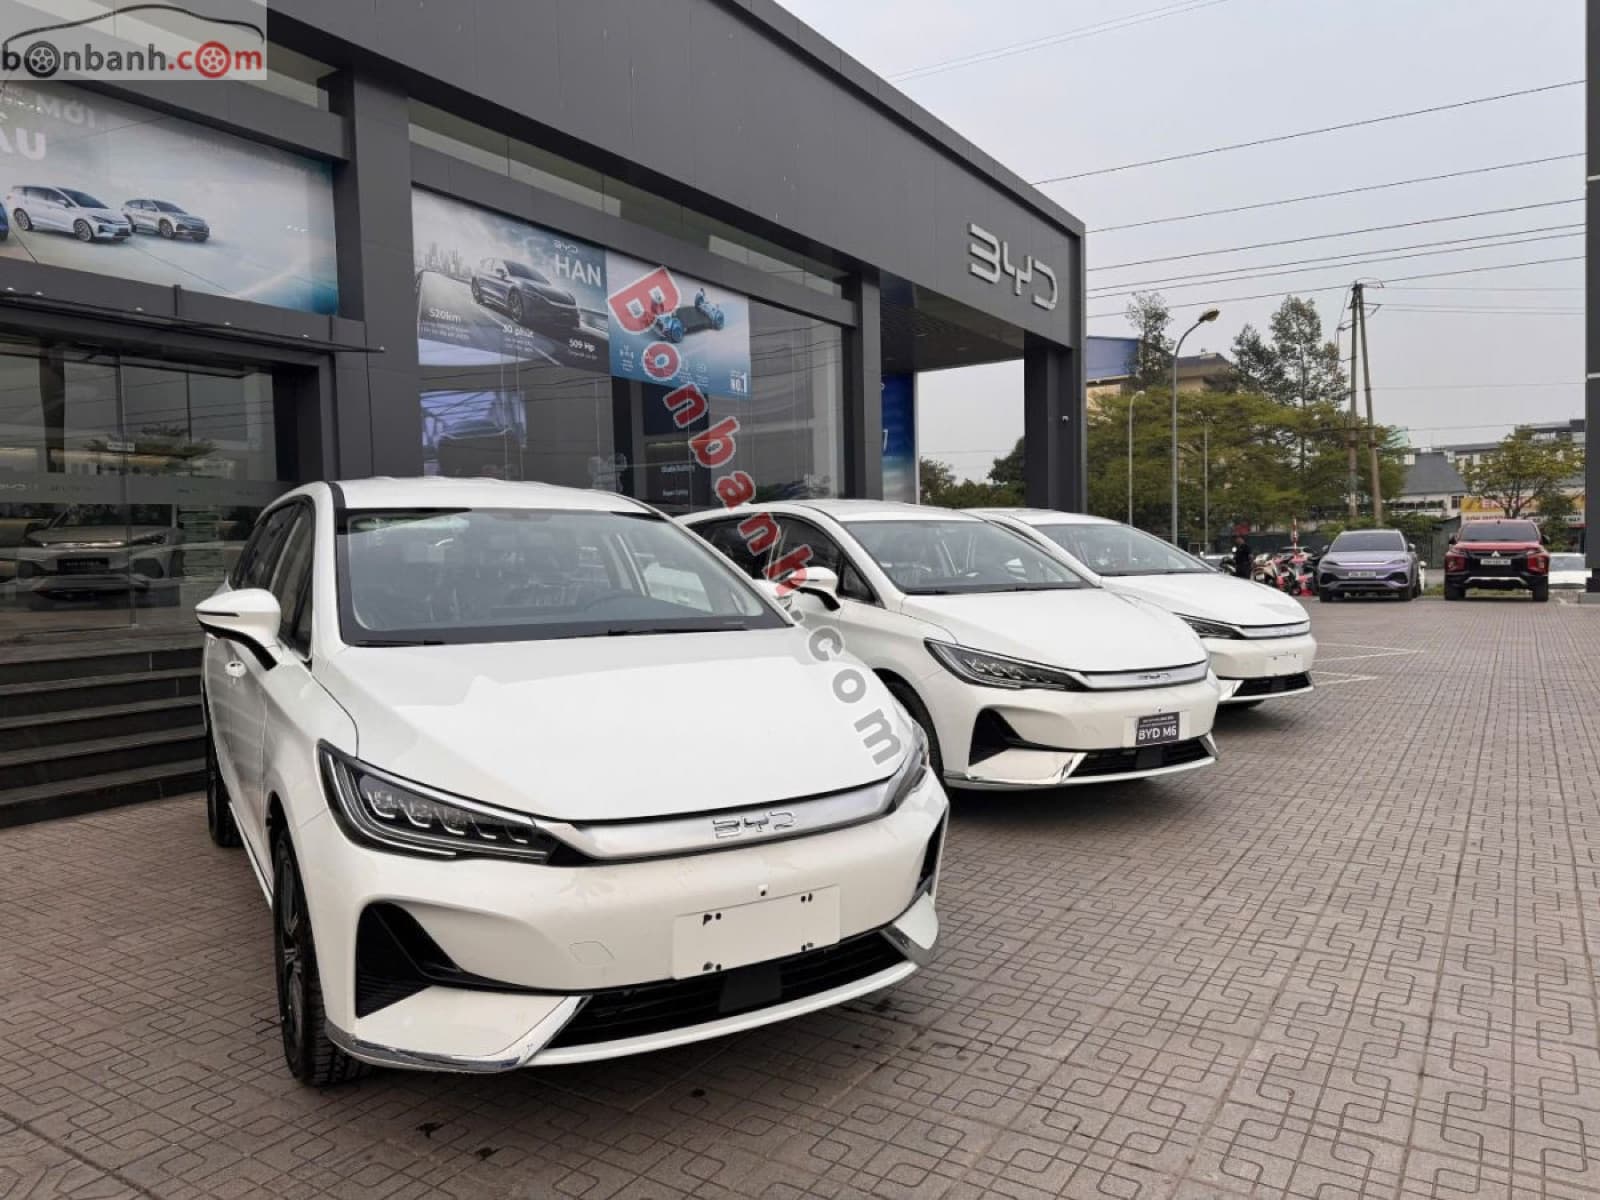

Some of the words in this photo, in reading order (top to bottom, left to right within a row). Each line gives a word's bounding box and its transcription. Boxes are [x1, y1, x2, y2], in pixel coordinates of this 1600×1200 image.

[554, 253, 603, 288] HAN
[967, 223, 1058, 311] BYD
[1138, 727, 1161, 741] BYD
[1162, 724, 1177, 738] M6
[712, 809, 797, 840] BYD
